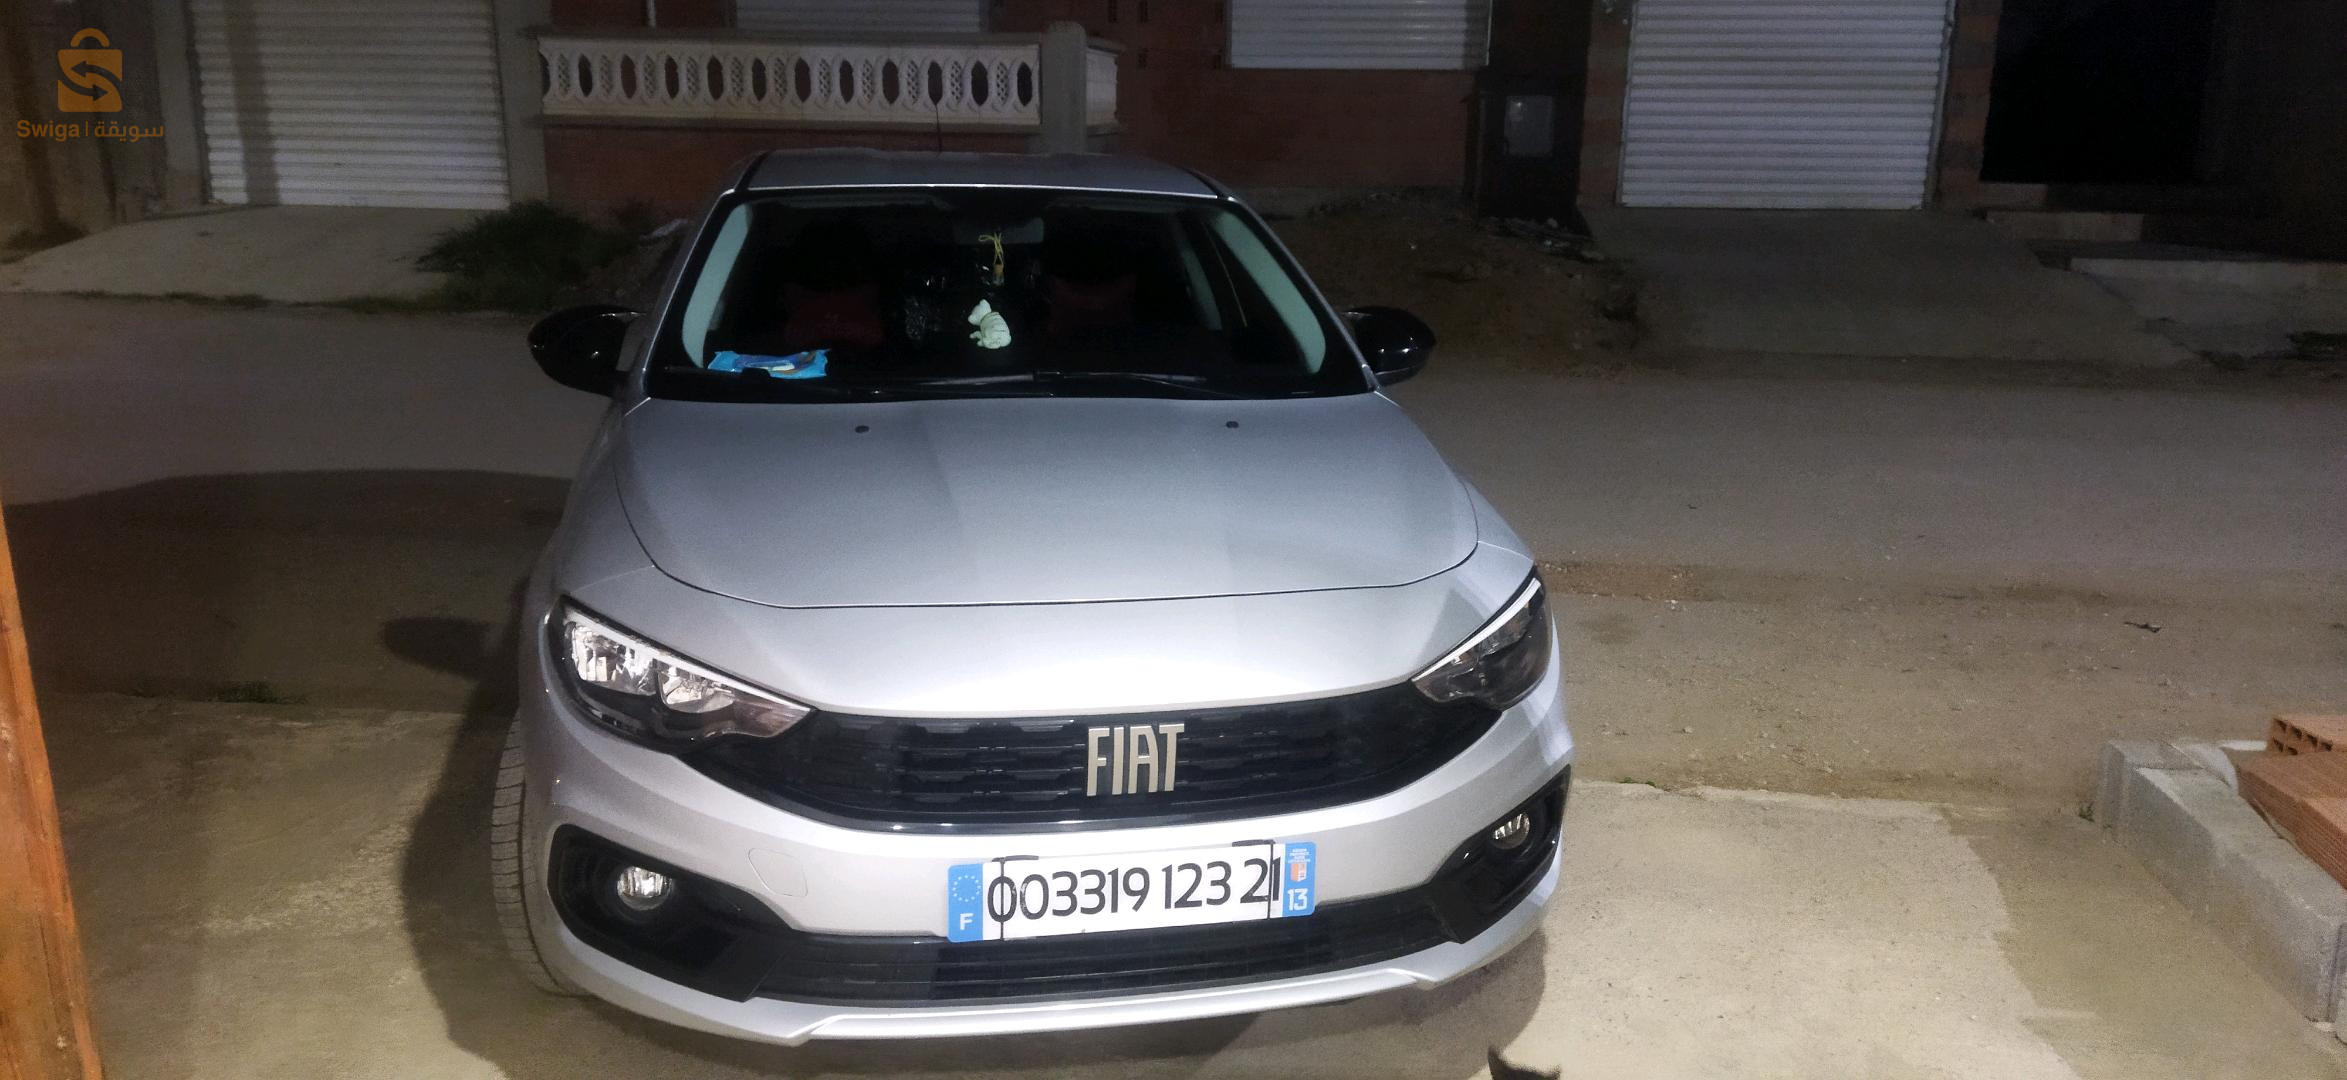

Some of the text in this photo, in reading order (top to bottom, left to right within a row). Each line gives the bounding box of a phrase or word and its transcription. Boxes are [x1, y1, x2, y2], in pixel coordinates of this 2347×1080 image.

[1086, 722, 1185, 797] FIAT
[987, 857, 1282, 924] 003319 123 21
[1287, 887, 1309, 912] 13
[959, 912, 974, 931] F
